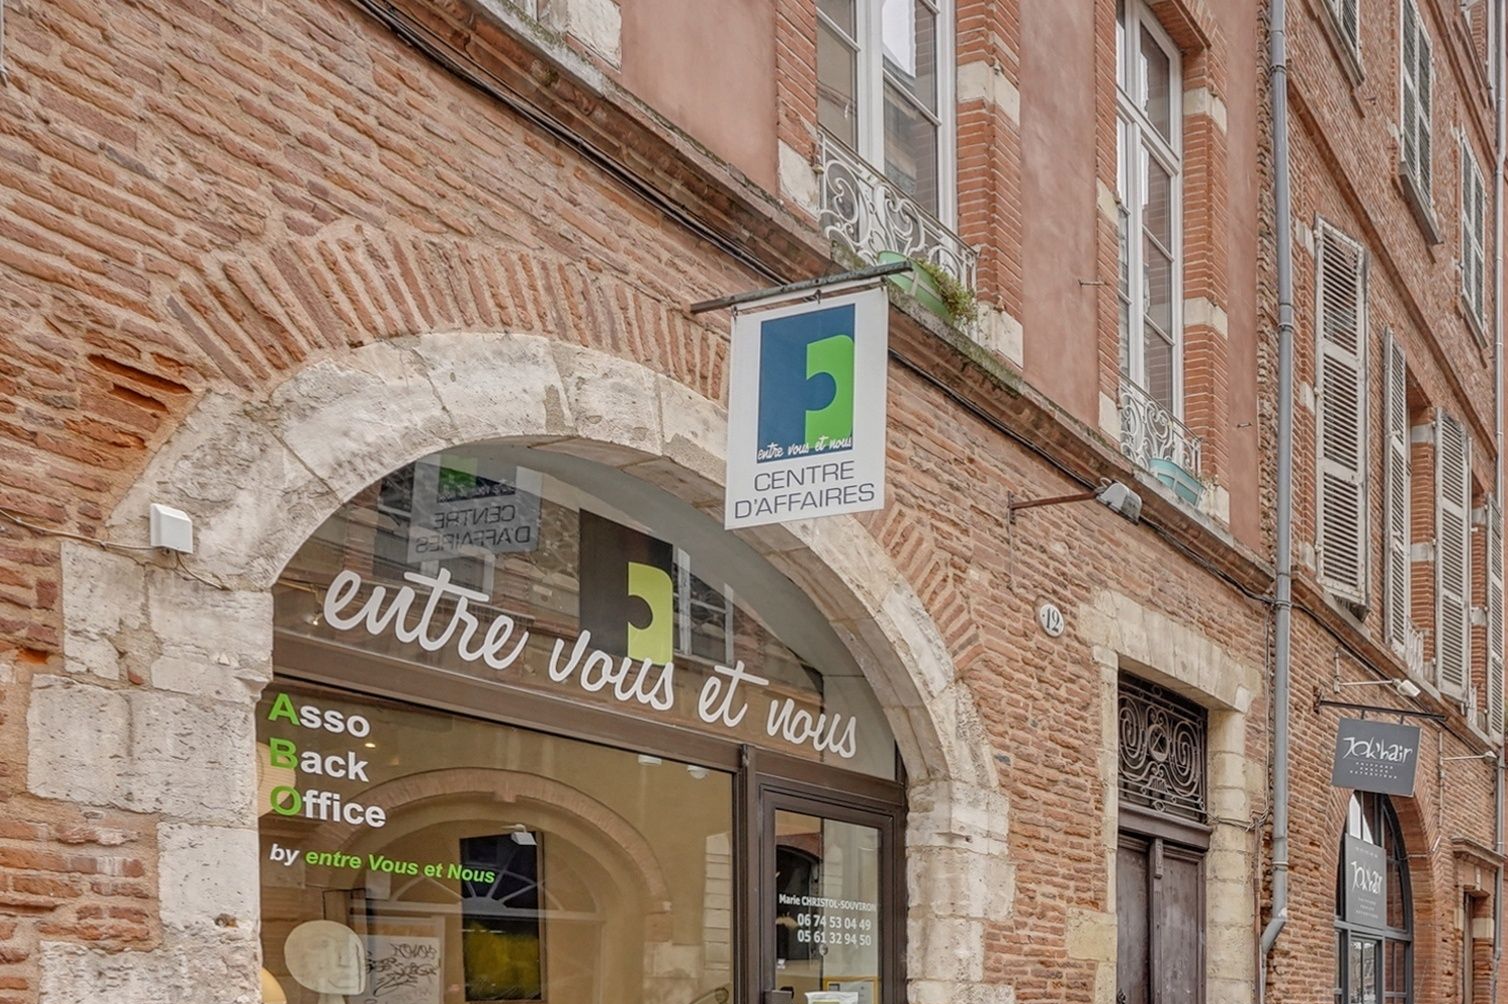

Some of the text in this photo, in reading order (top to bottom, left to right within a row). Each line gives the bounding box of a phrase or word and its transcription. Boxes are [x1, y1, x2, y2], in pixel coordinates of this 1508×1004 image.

[757, 435, 852, 460] entre vous et nous
[754, 460, 855, 492] CENTRE
[734, 482, 875, 519] D'AFFAIRES
[1046, 607, 1061, 633] 12
[323, 567, 857, 758] entre vous et nous
[268, 692, 371, 738] Asso
[269, 736, 370, 783] Back
[269, 784, 387, 829] Office
[269, 843, 496, 884] by entre Vous et Nous
[778, 893, 801, 905] Marie
[797, 913, 872, 930] 06 74 53 04 49
[797, 930, 872, 945] 05 61 32 94 50
